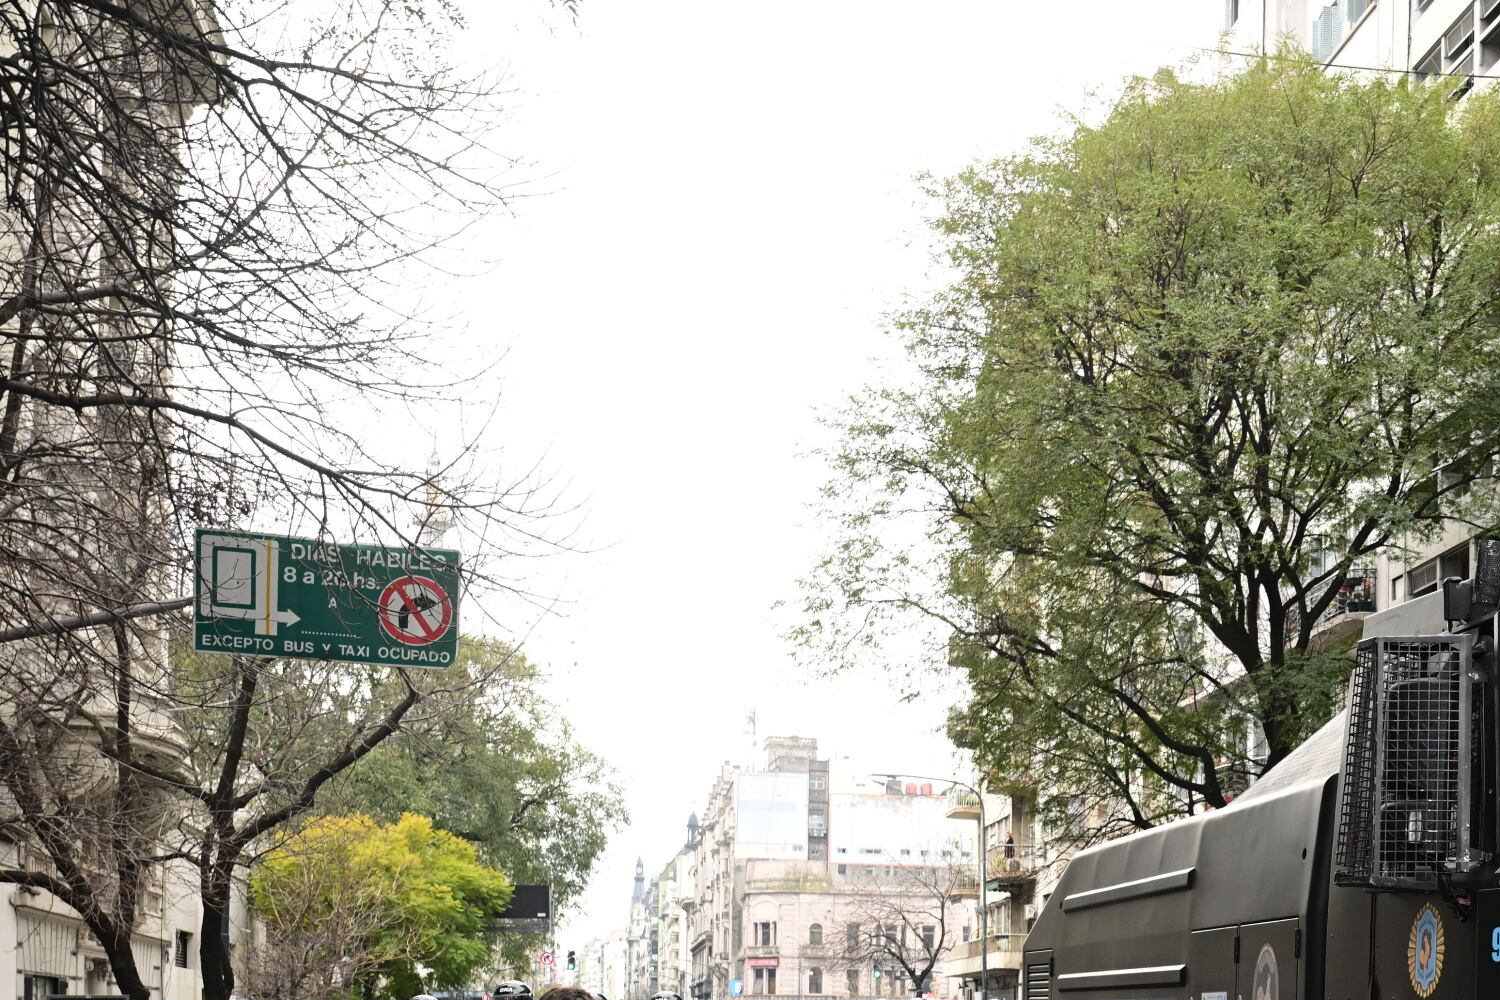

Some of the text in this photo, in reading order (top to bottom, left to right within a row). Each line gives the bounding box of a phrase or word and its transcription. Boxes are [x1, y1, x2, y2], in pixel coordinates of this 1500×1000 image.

[291, 543, 448, 572] DIAS HABILES
[283, 566, 297, 583] 8
[303, 570, 315, 585] a
[328, 597, 337, 609] A
[202, 634, 274, 651] EXCEPTO
[284, 640, 315, 654] BUS
[339, 644, 370, 658] TAXI
[378, 646, 451, 664] OCUPADO
